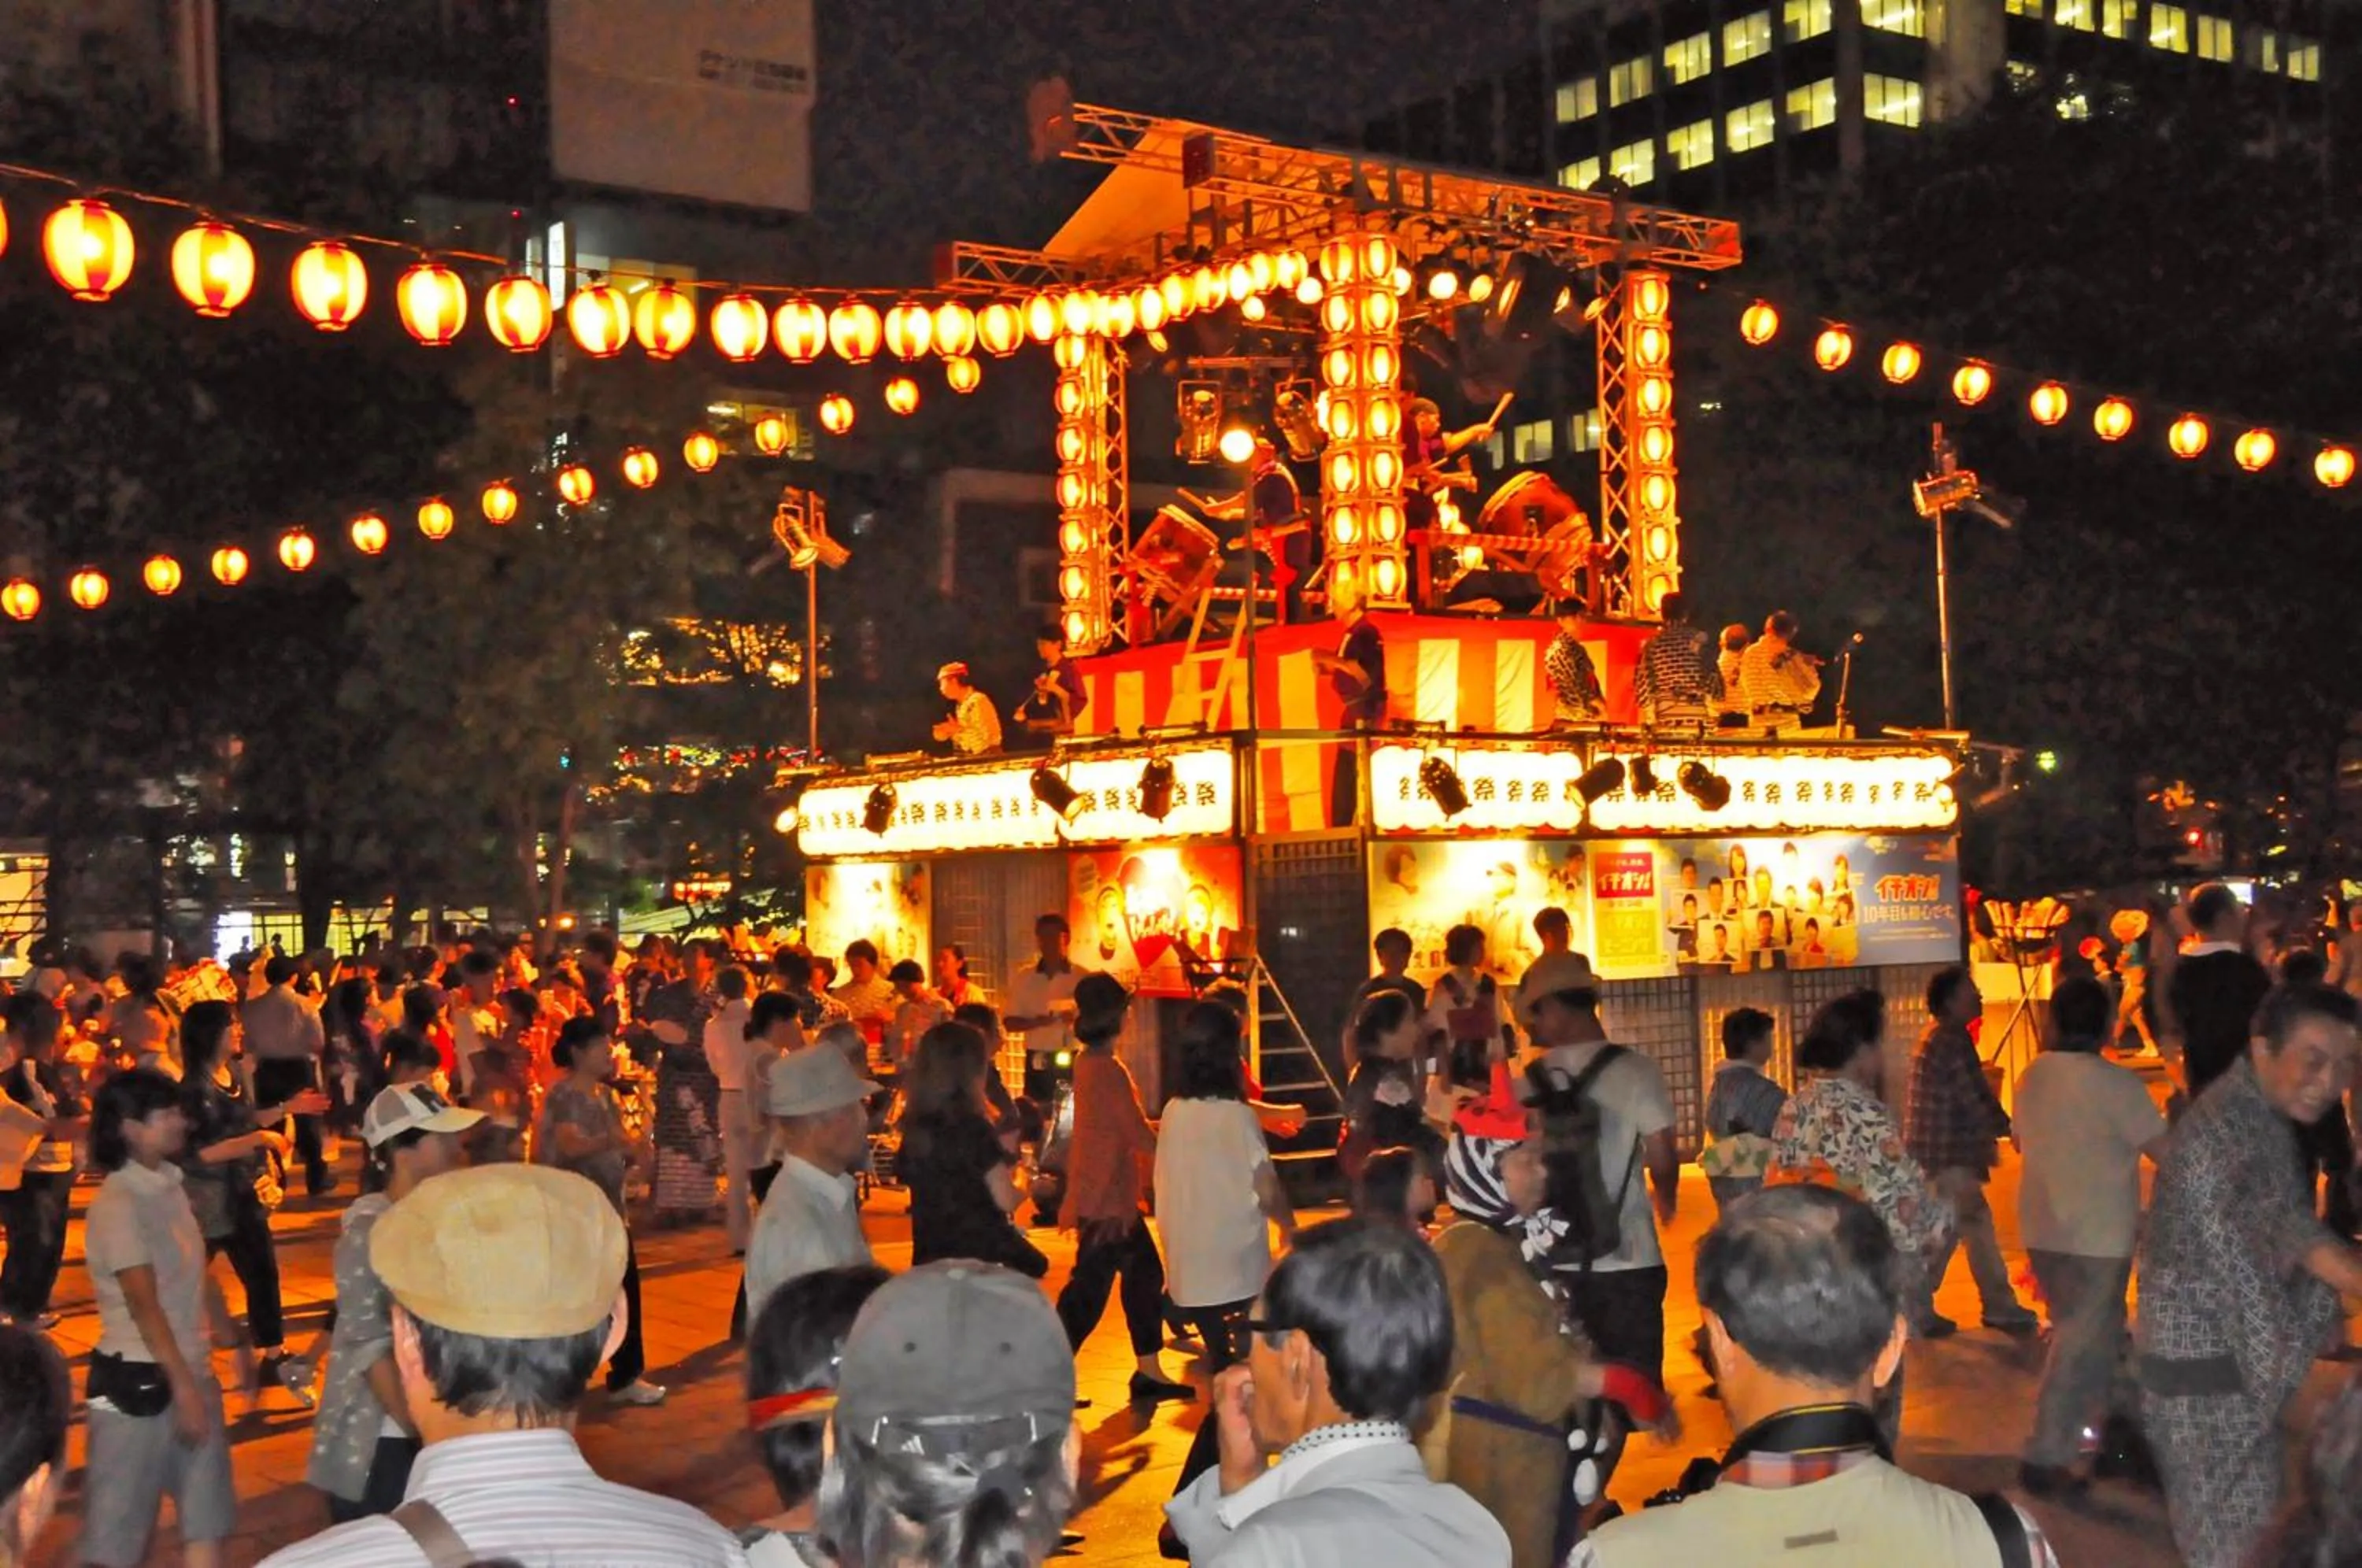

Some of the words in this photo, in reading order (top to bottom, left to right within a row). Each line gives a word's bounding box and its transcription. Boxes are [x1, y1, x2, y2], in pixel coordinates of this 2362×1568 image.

[1197, 782, 1216, 805] 祭
[1473, 777, 1494, 800] 祭
[1531, 781, 1549, 801] 祭
[1764, 782, 1781, 804] 祭
[1797, 781, 1812, 802] 祭
